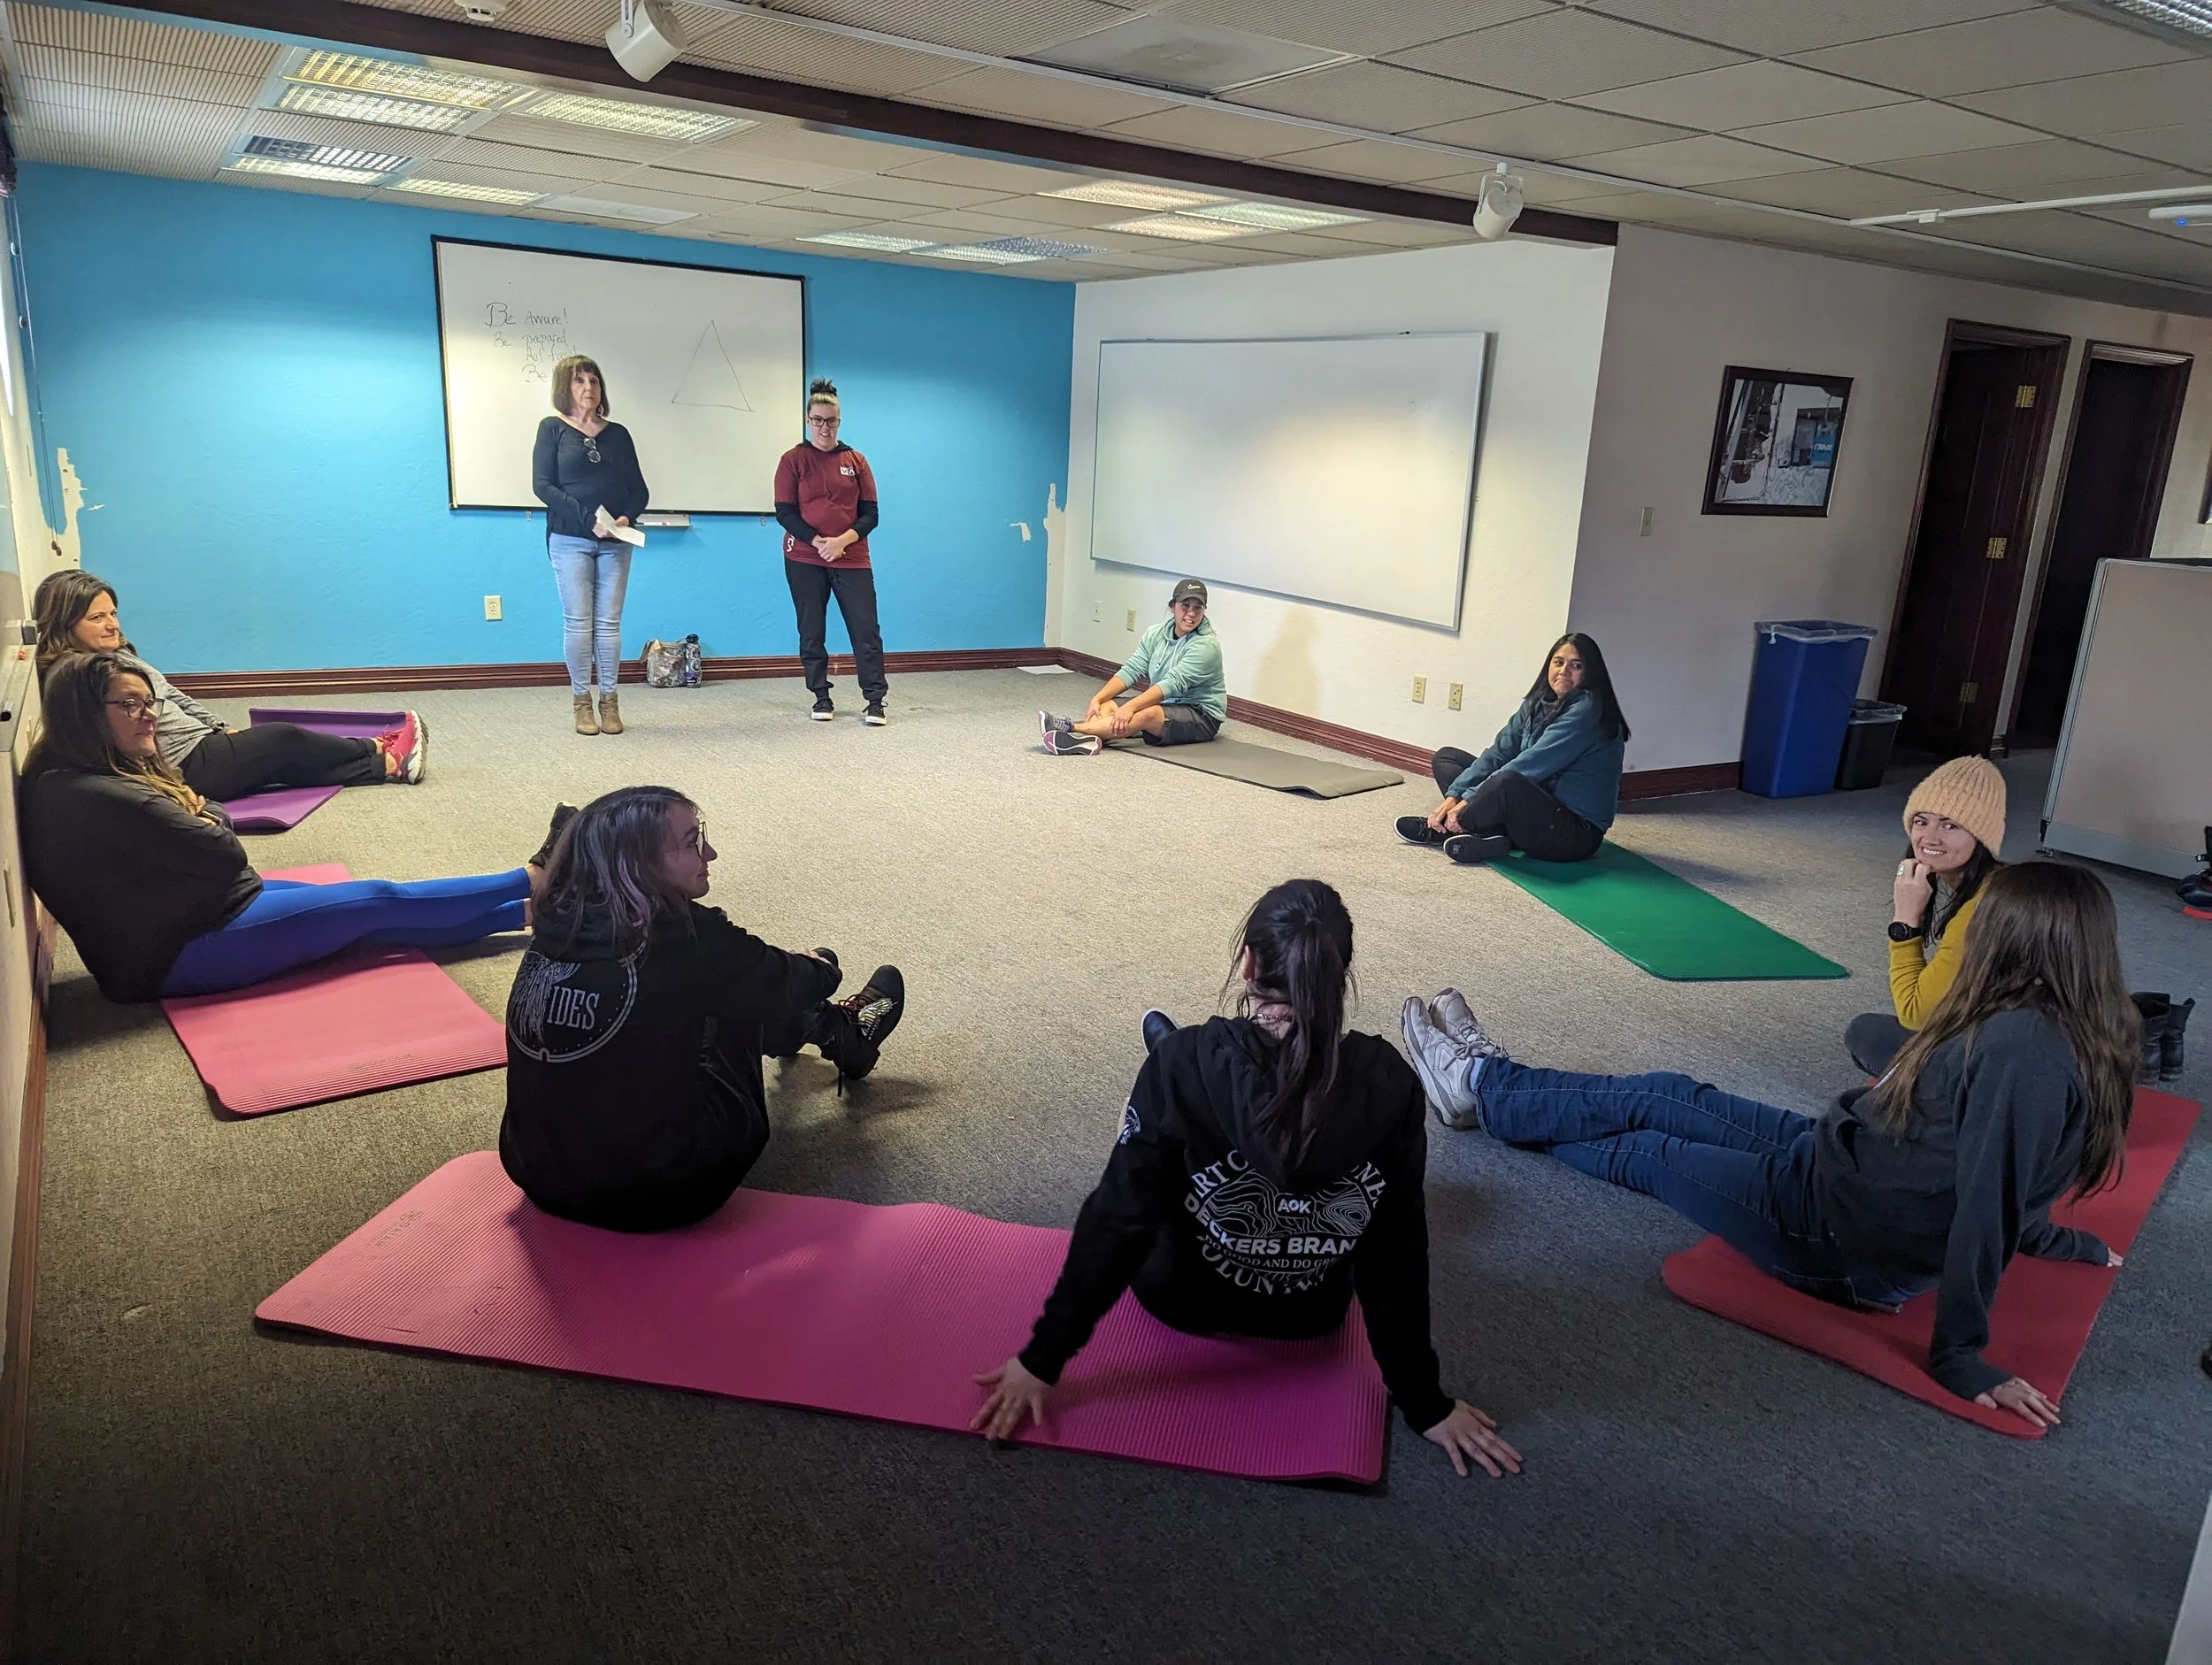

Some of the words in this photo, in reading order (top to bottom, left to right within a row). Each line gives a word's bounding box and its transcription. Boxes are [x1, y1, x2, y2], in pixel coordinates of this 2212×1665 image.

[484, 303, 517, 328] Be
[494, 331, 511, 348] Be
[521, 328, 568, 350] prepared
[522, 364, 548, 383] Be
[1277, 1197, 1312, 1215] AOK
[1183, 1192, 1282, 1255] DECKERS
[1286, 1237, 1358, 1255] BRAN
[1263, 1258, 1290, 1269] AND
[1292, 1259, 1311, 1269] DO
